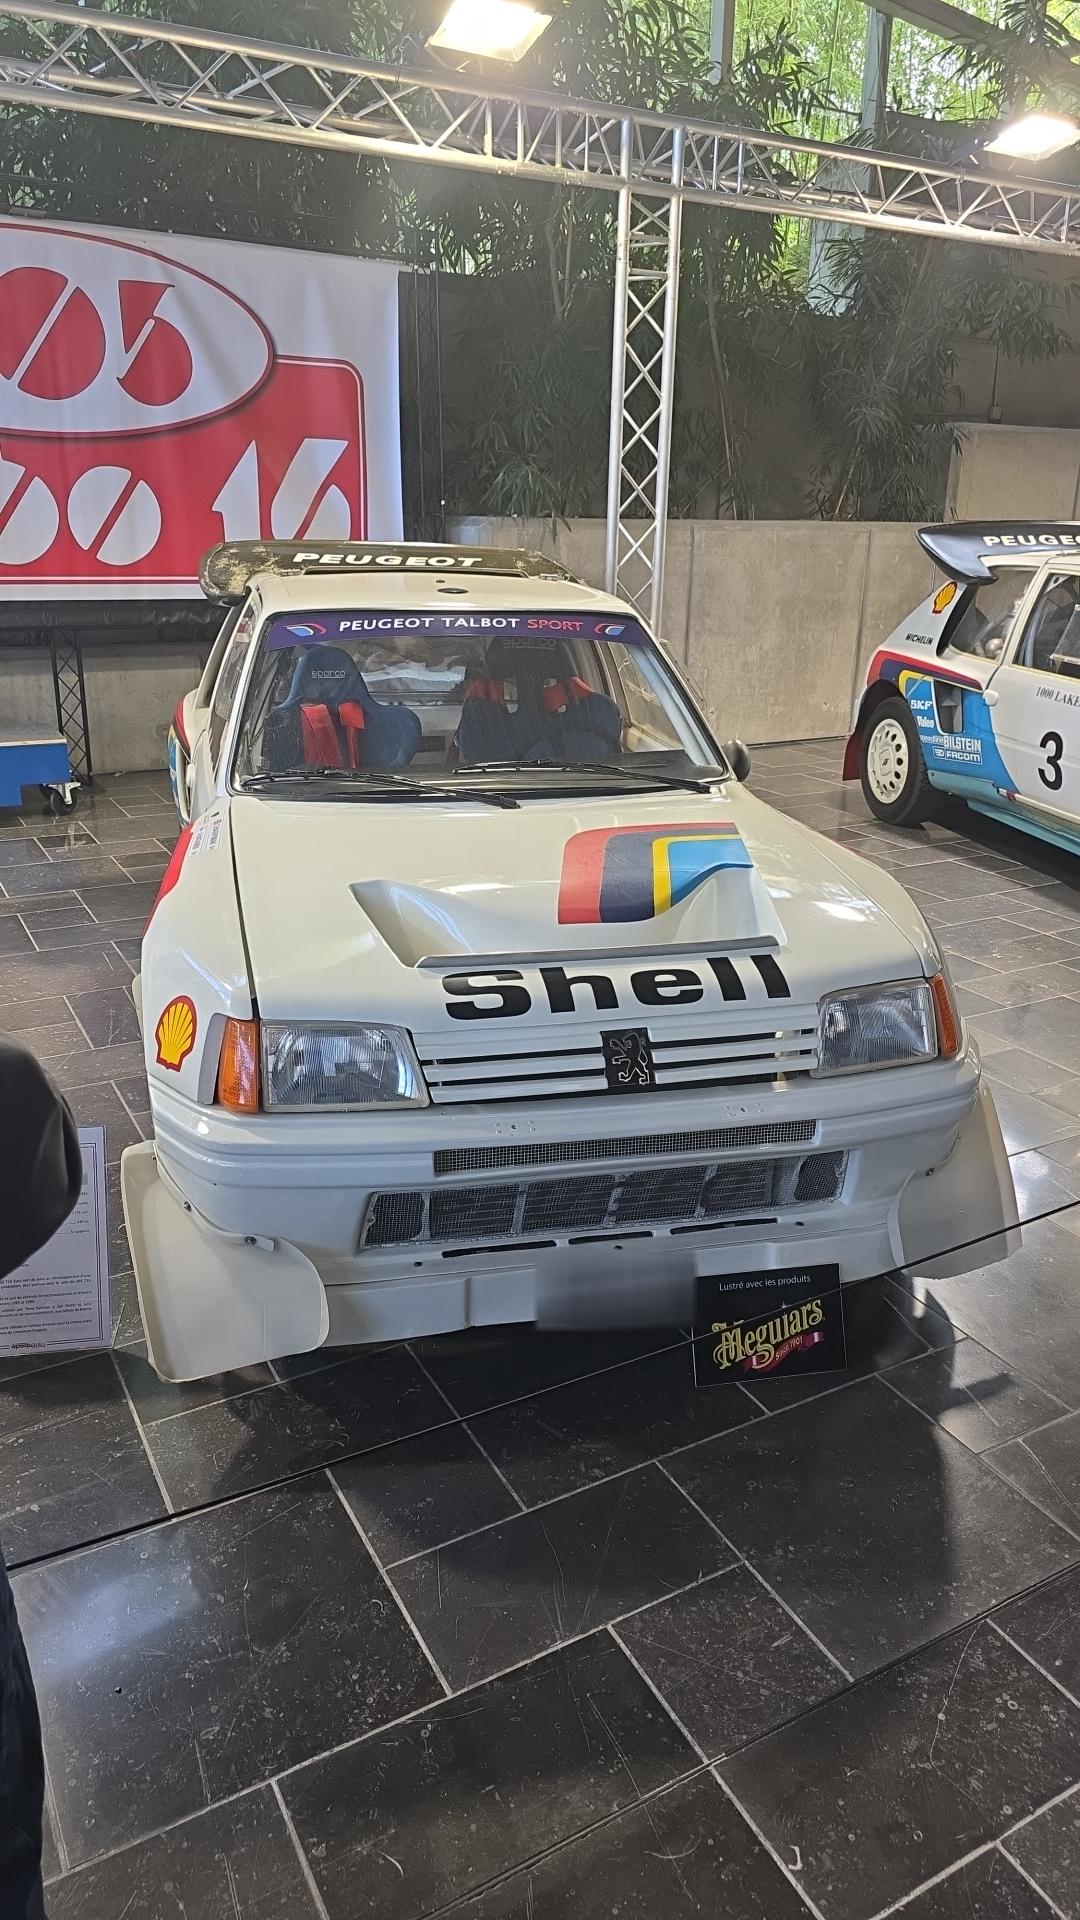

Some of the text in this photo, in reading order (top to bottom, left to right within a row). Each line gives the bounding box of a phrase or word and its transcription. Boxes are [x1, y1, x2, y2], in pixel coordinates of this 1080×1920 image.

[292, 552, 483, 568] PEUGEOT
[338, 617, 584, 632] PEUGEOT TALBOT SPORT
[905, 633, 934, 645] MICHELIN
[311, 670, 346, 679] sparco
[1036, 686, 1055, 699] 1000
[910, 699, 933, 711] SKF
[944, 735, 982, 752] BILSTEIN
[1037, 731, 1064, 791] 3
[441, 954, 791, 1020] Shell
[719, 1275, 811, 1291] Lustré avec les produits
